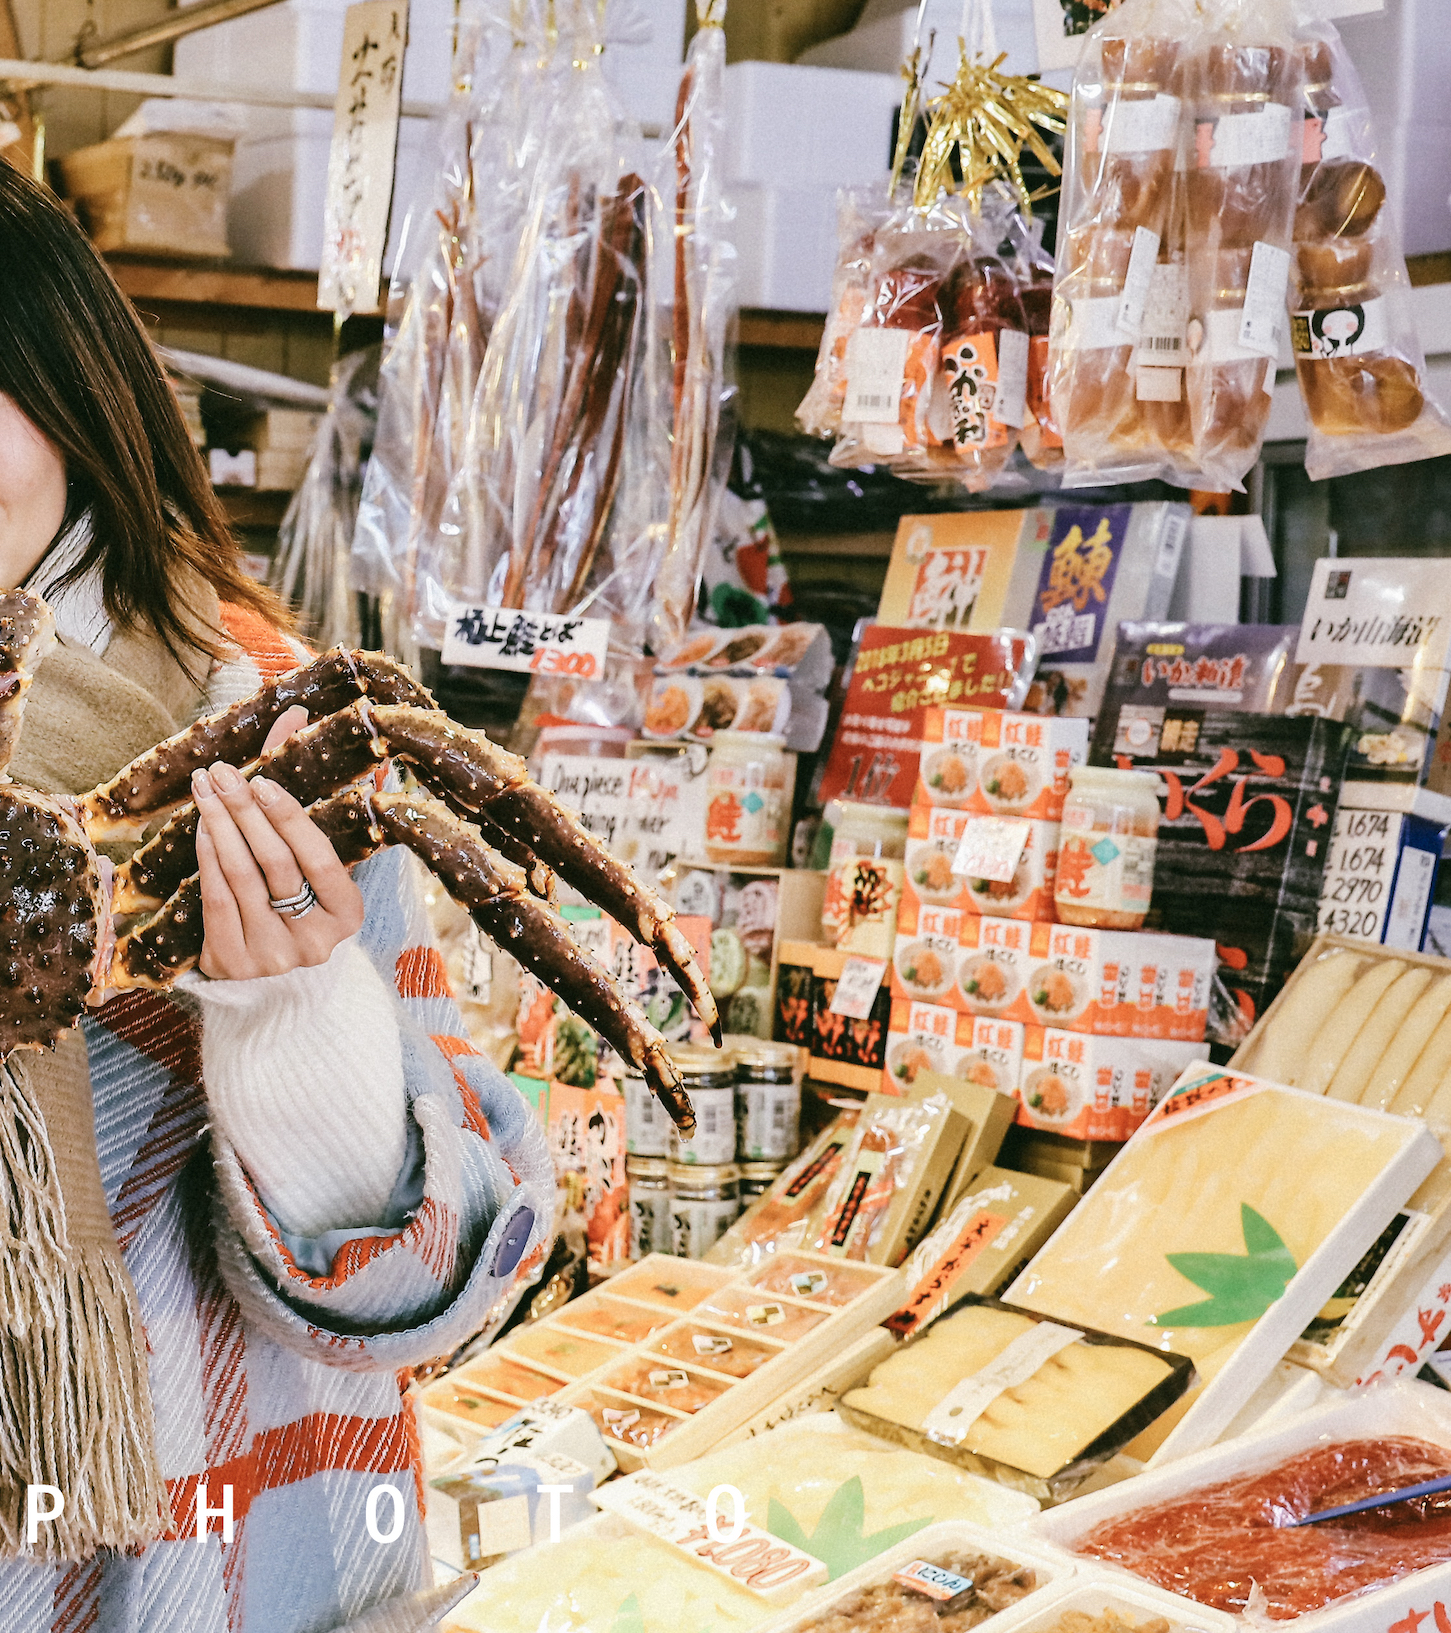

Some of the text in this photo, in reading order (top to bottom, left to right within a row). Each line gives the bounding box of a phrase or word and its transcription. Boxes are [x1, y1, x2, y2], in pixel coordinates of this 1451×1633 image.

[1310, 615, 1441, 646] いか山海漬
[529, 648, 595, 678] 1300
[1347, 813, 1389, 837] 1674
[1340, 847, 1385, 874] 1674
[1331, 877, 1383, 903] 2970
[1323, 909, 1378, 937] 4320
